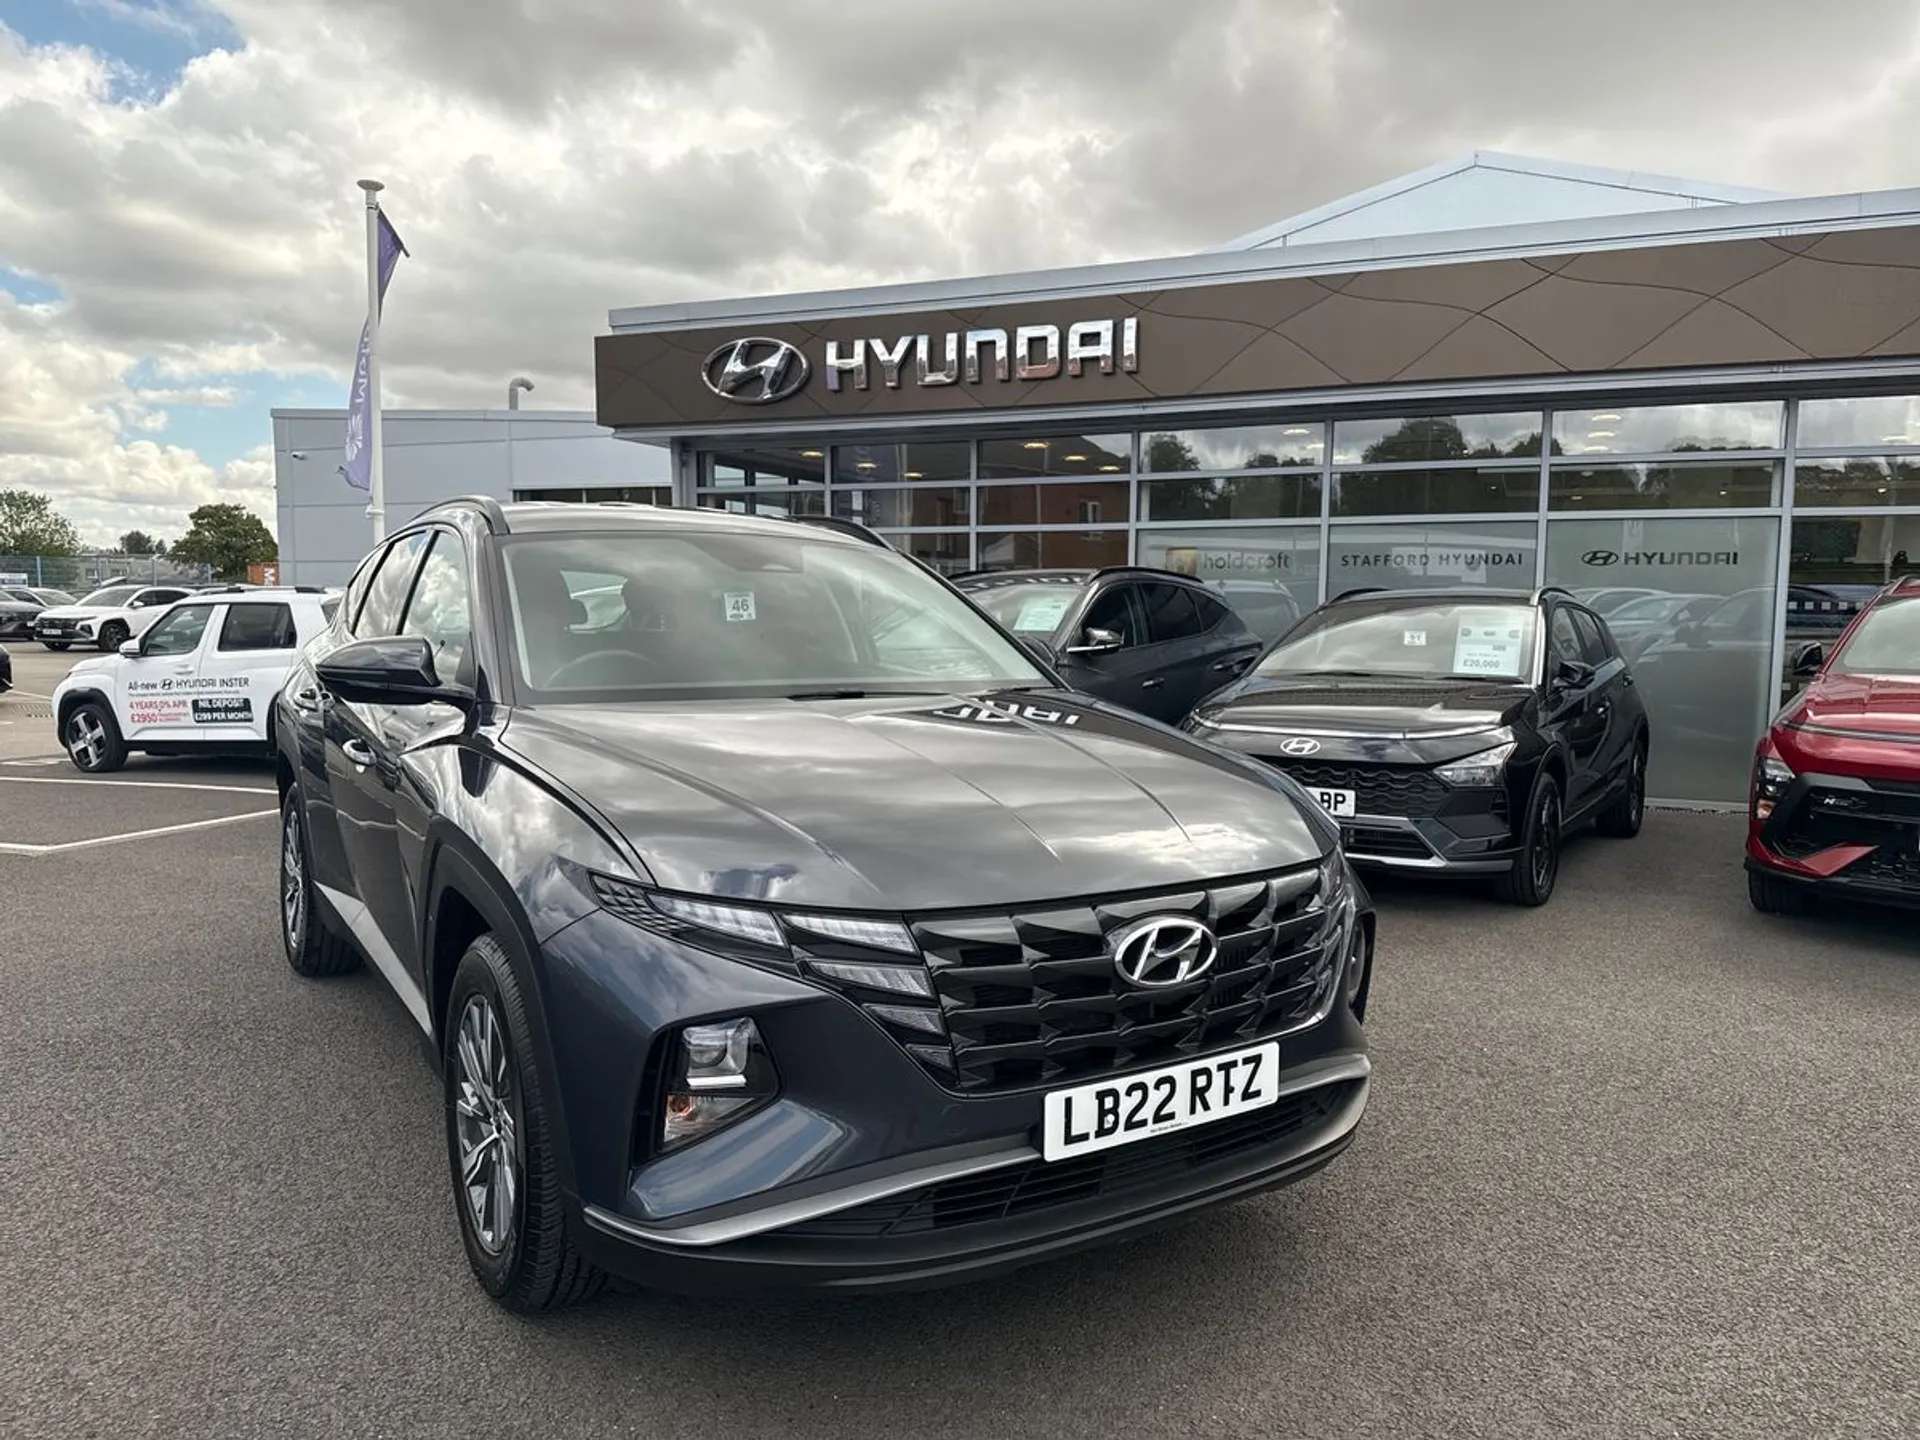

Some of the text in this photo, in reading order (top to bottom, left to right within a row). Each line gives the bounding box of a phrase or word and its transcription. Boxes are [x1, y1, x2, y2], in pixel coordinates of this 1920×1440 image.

[824, 317, 1140, 392] HYUNDAI
[1203, 551, 1291, 569] holdcroft
[1341, 552, 1523, 567] STAFFORD HYUNDAI
[1623, 551, 1738, 566] HYUNDAI
[732, 598, 749, 612] 46
[128, 677, 249, 691] All-new HYUNDAI INSTER
[135, 700, 158, 709] YEARS
[172, 700, 188, 708] APR
[212, 698, 244, 708] DEPOSIT
[213, 711, 227, 720] PER
[228, 711, 253, 720] MONTH
[1063, 1053, 1262, 1147] LB22 RTZ
